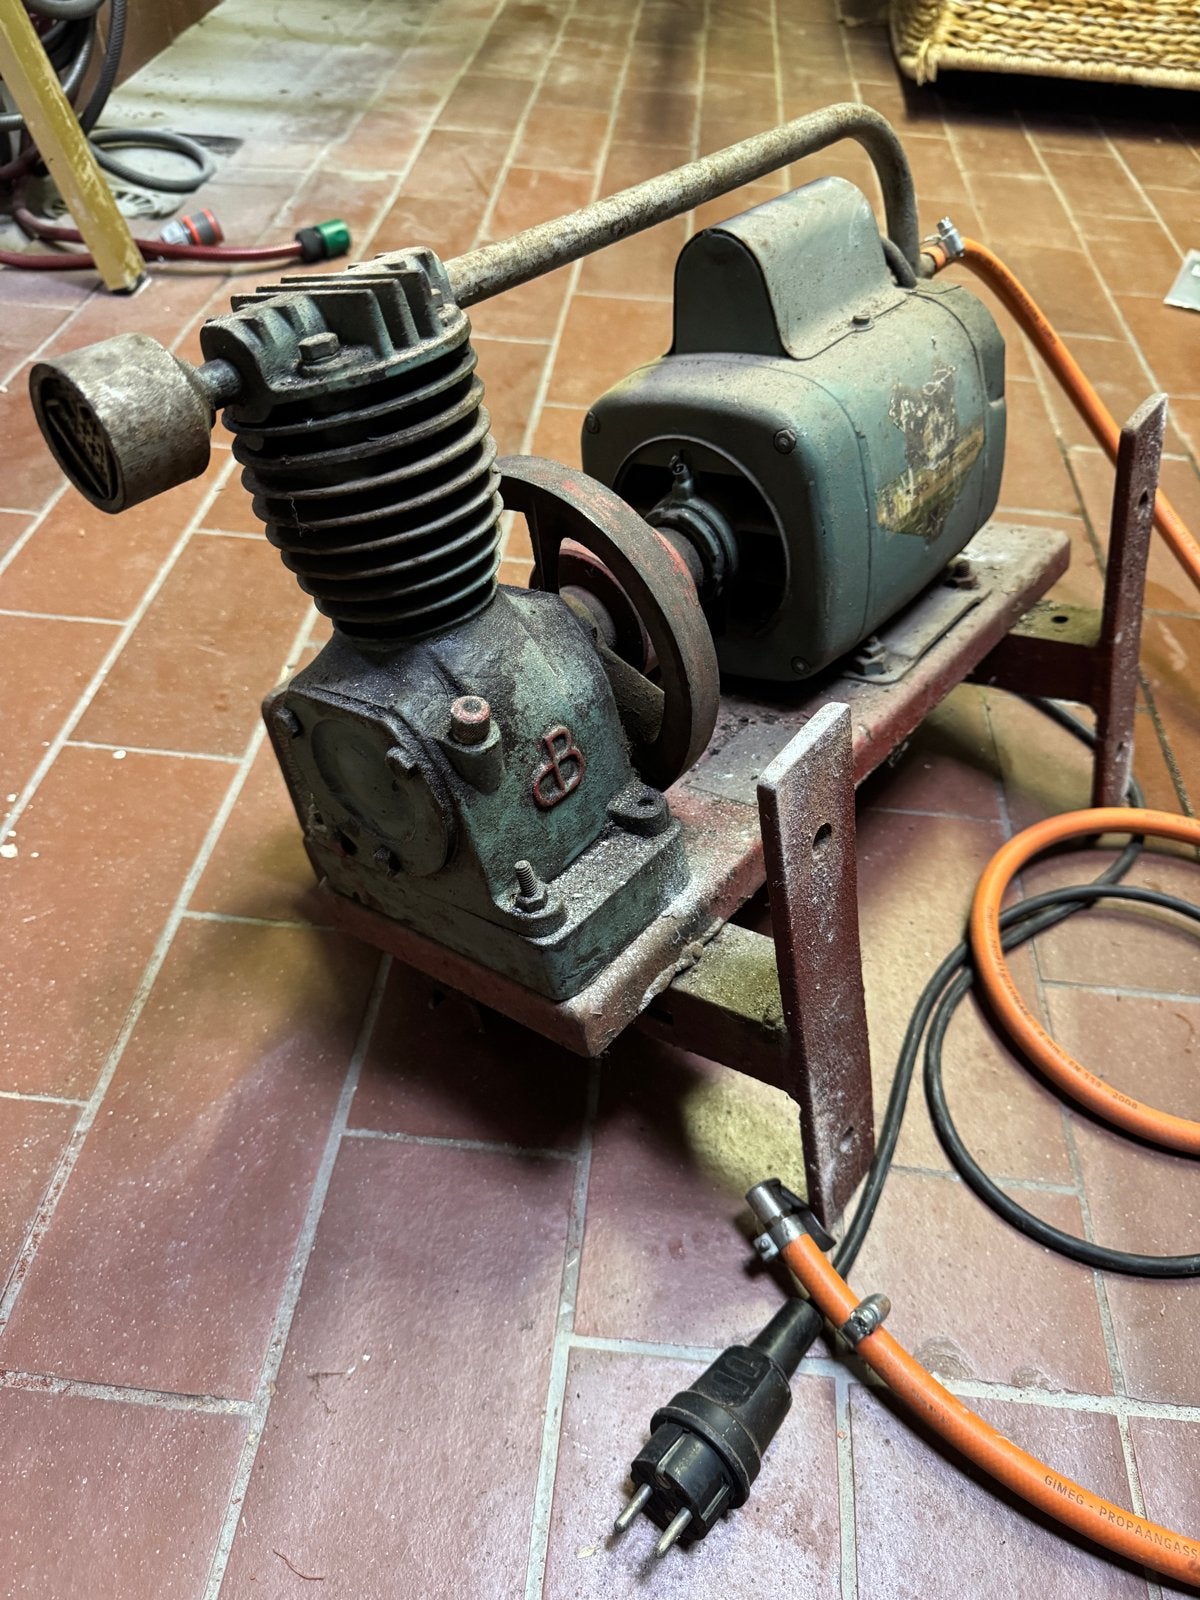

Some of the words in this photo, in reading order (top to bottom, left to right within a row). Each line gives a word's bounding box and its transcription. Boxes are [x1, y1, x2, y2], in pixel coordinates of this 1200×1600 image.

[1112, 1091, 1138, 1110] 2008
[1044, 1474, 1084, 1505] GIMEG
[1099, 1506, 1198, 1560] PROPAANGASS
